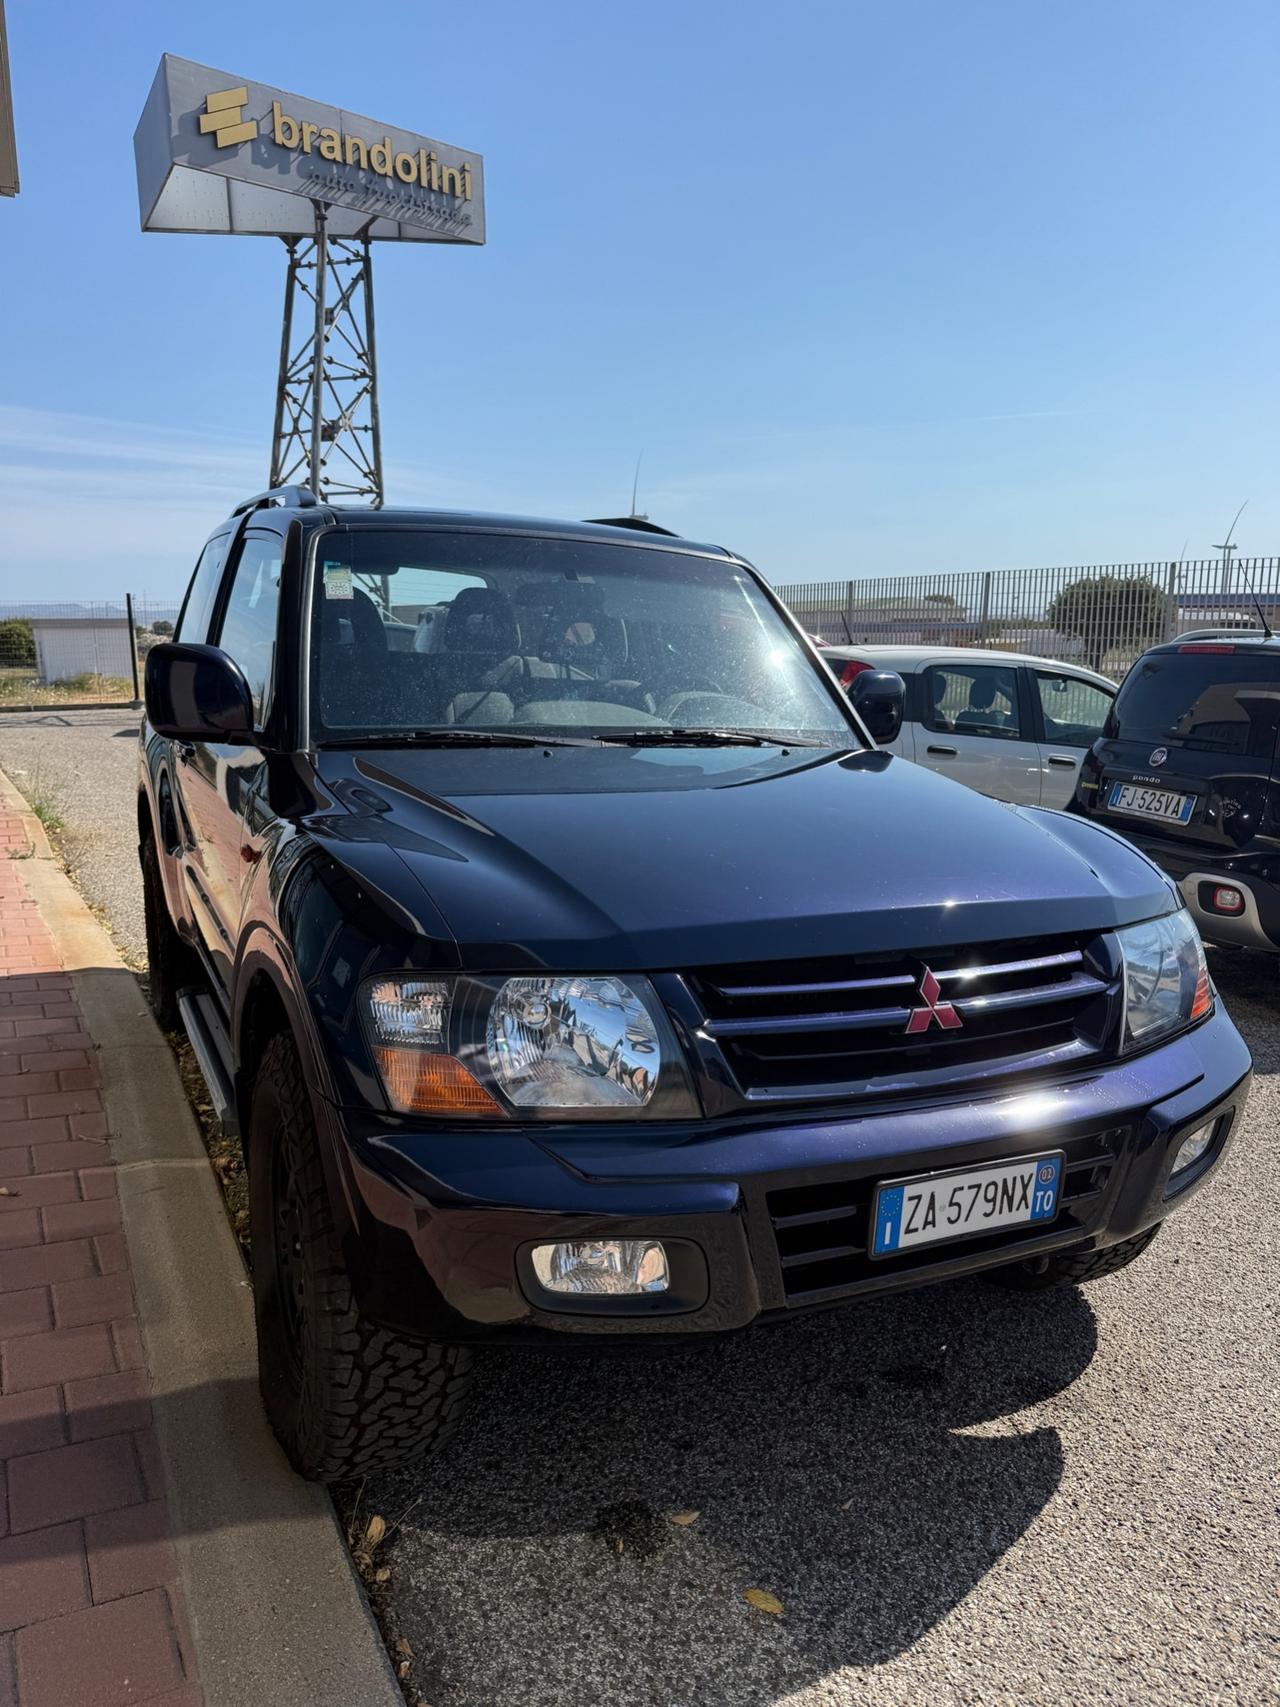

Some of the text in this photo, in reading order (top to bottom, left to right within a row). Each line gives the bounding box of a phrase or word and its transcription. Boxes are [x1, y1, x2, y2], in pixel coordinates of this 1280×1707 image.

[273, 101, 472, 200] brandolini
[1118, 787, 1138, 807] FJ
[1138, 790, 1181, 817] 525VA
[904, 1191, 936, 1235] ZA
[947, 1172, 1034, 1225] 579NX
[1035, 1190, 1054, 1212] TO
